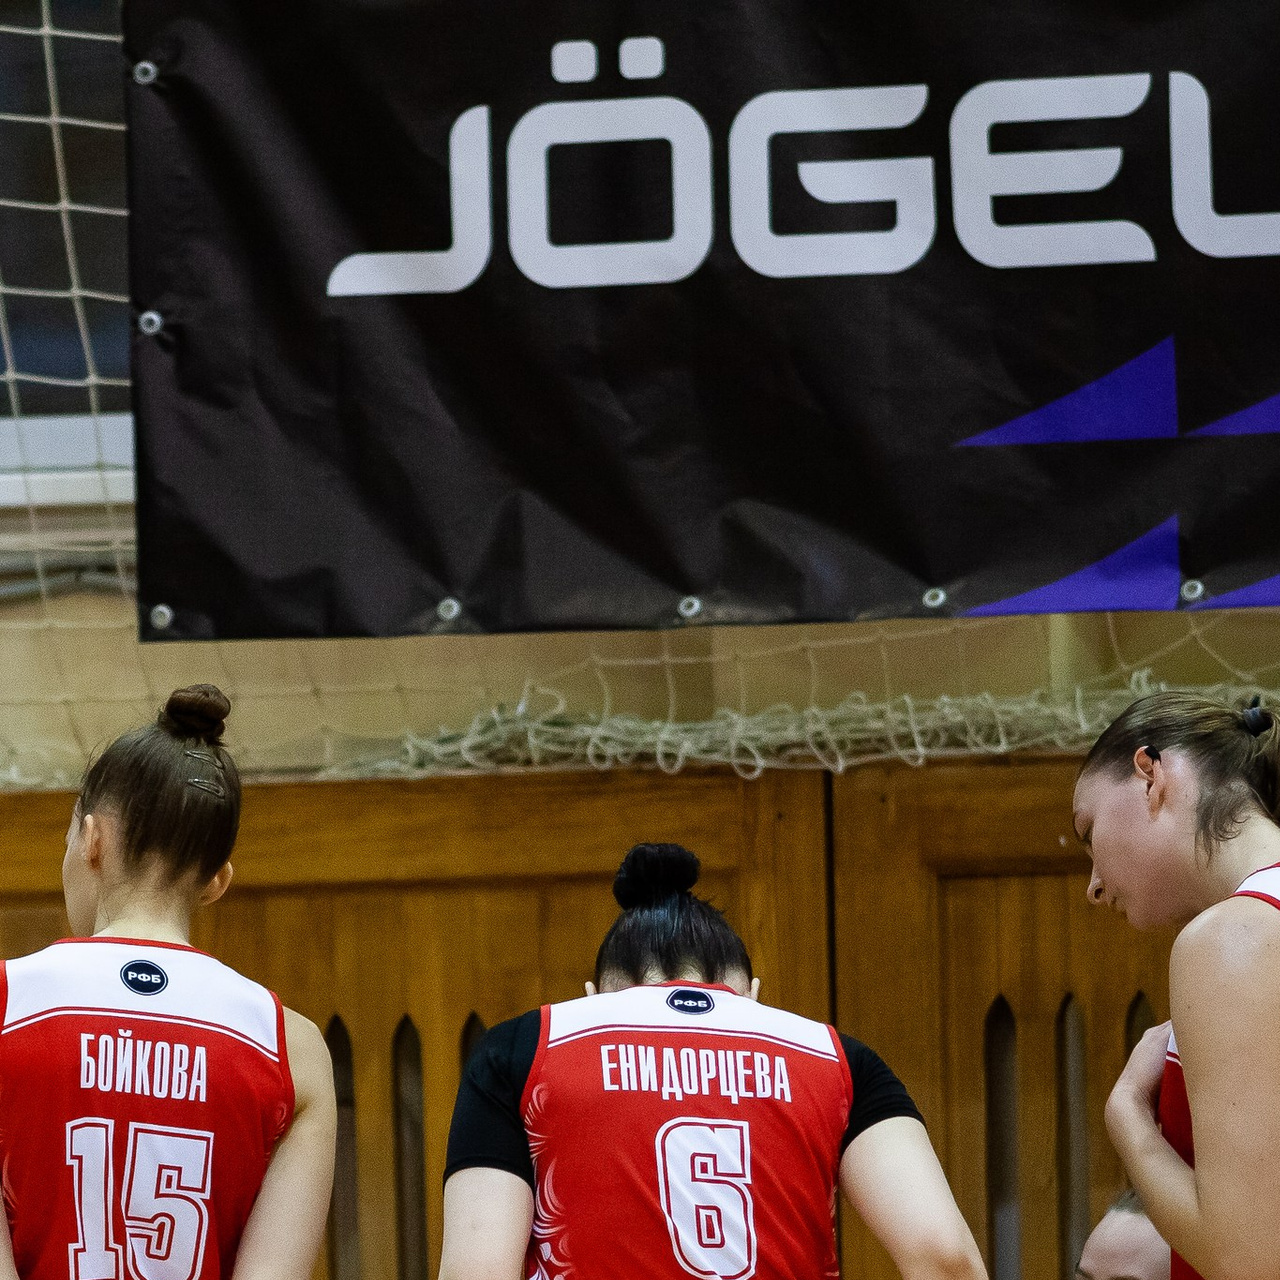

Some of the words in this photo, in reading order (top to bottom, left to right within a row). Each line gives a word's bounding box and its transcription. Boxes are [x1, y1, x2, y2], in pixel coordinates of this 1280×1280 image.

[327, 36, 1280, 297] JÖGEL
[127, 970, 162, 985] РФБ
[673, 997, 708, 1009] РФБ
[80, 1029, 207, 1103] БОЙКОВА
[600, 1044, 792, 1105] ЕНИДОРЦЕВА
